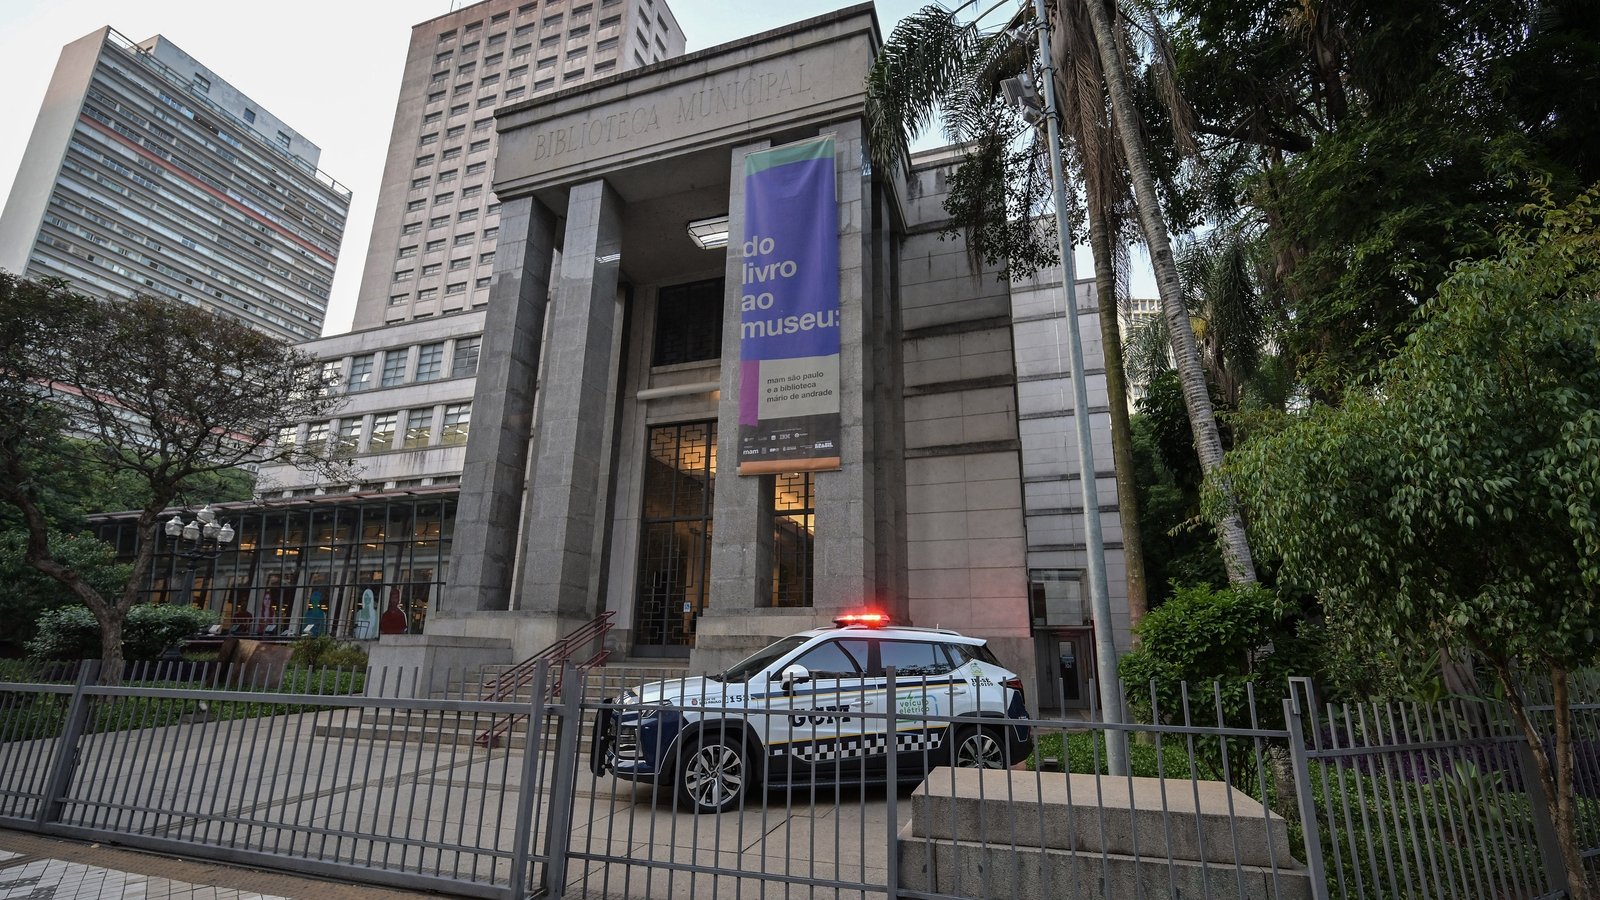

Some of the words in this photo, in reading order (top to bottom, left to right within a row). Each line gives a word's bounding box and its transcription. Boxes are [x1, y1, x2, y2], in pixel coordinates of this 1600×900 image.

[533, 105, 661, 161] BIBLIOTECA
[676, 63, 811, 125] MUNICIPAL
[743, 235, 775, 258] do
[742, 260, 798, 285] livro
[741, 292, 774, 312] ao
[740, 309, 840, 340] museu:
[780, 382, 817, 392] biblioteca
[787, 374, 801, 382] são
[802, 371, 824, 381] paulo
[766, 394, 788, 403] mário
[790, 392, 800, 400] de
[801, 388, 833, 399] andrade
